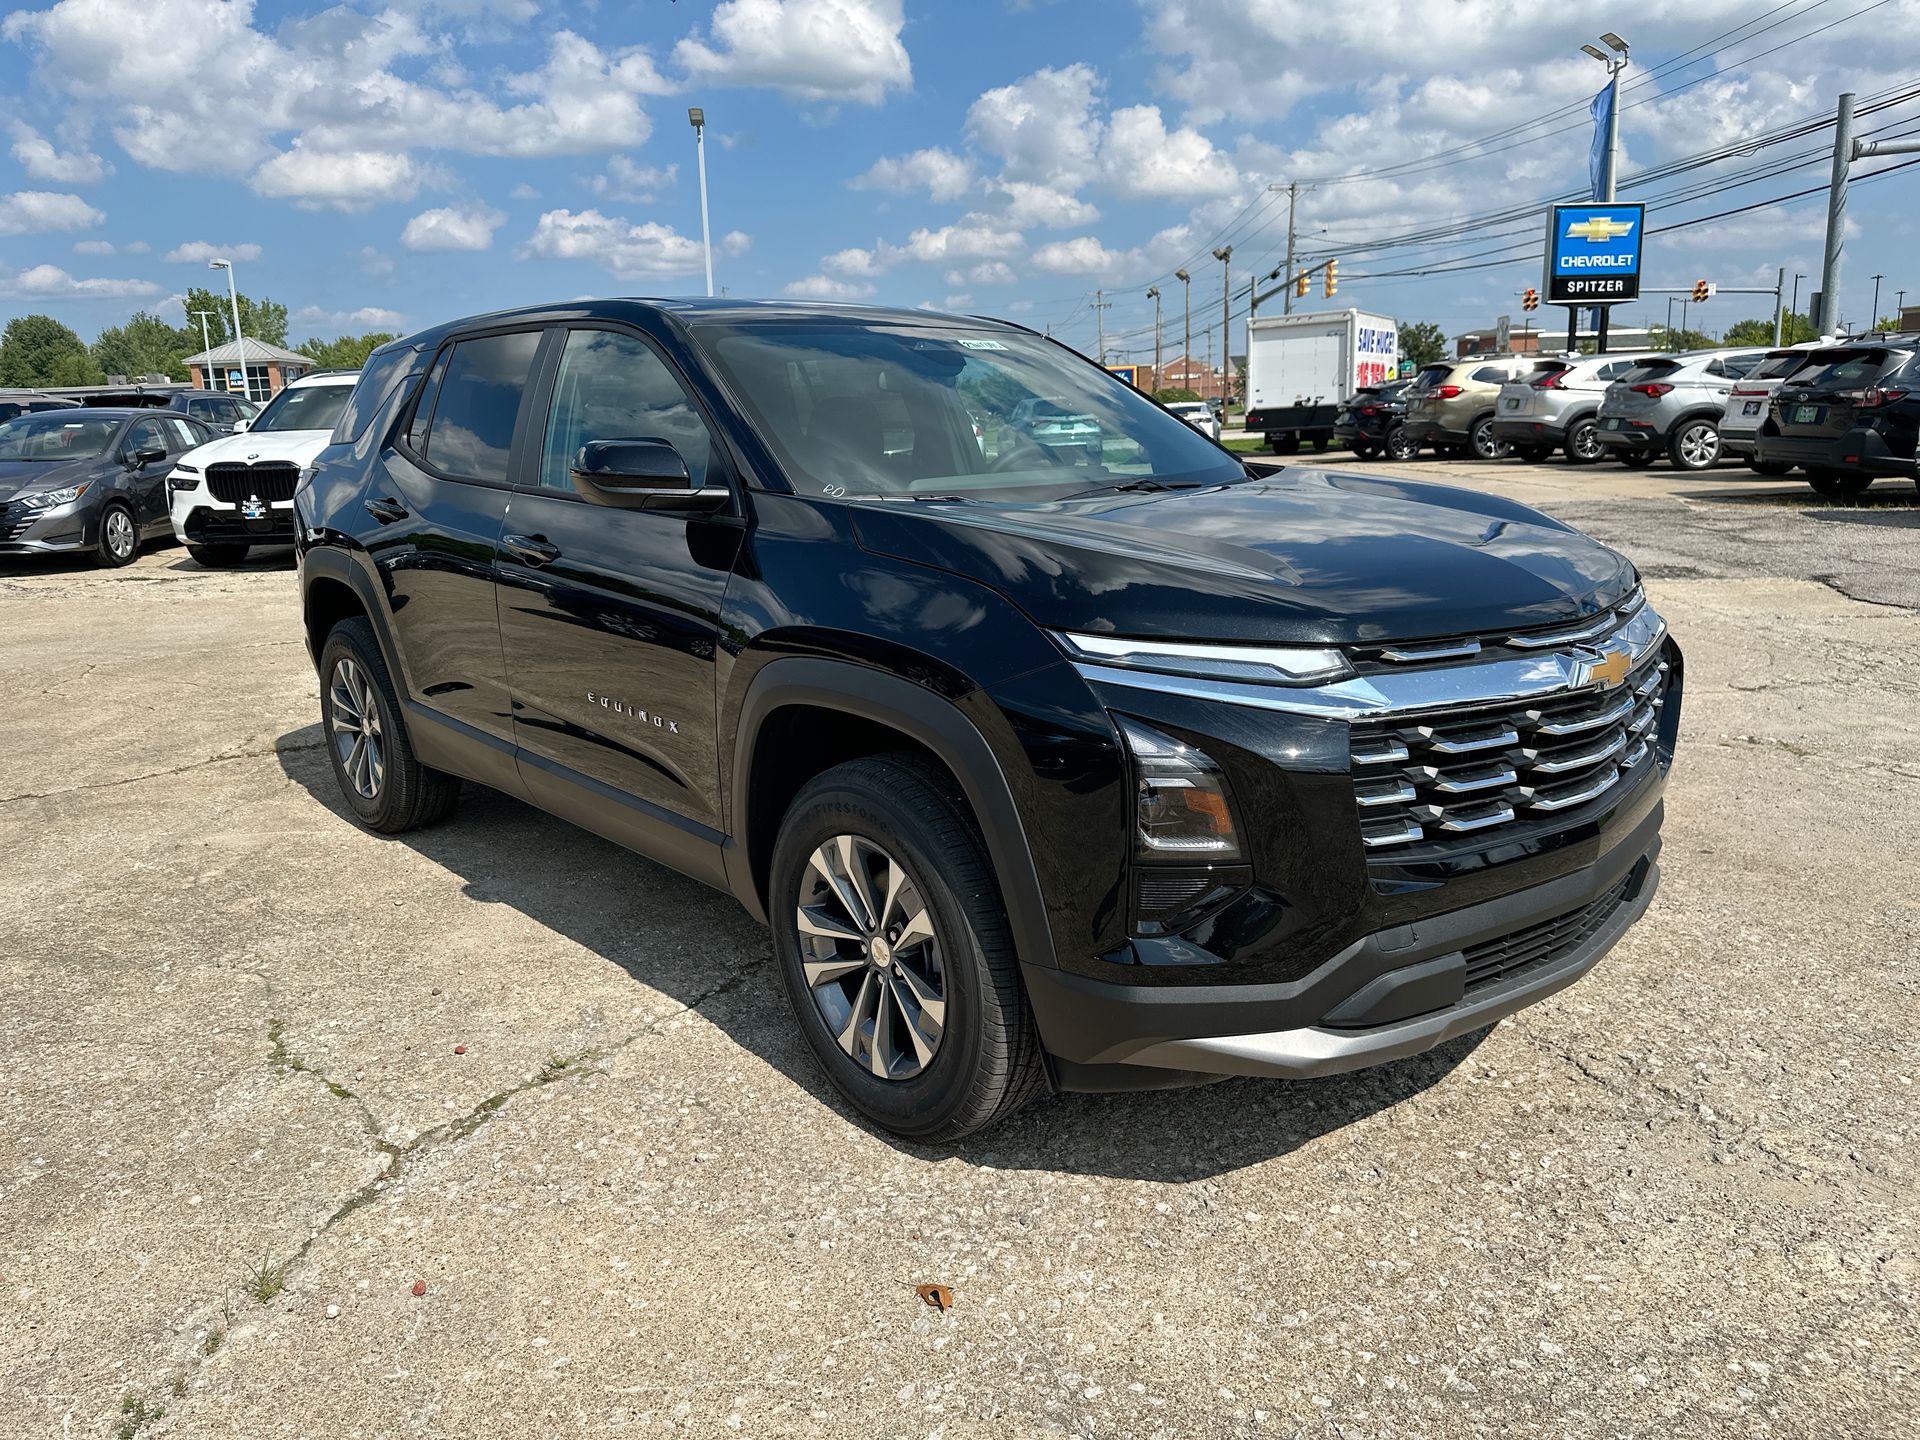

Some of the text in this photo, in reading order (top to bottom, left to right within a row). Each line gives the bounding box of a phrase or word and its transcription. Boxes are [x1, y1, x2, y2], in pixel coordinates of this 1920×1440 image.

[1560, 254, 1634, 268] CHEVROLET
[1567, 280, 1623, 293] SPITZER
[1358, 327, 1375, 353] SAVE
[587, 691, 679, 734] EQUINOX
